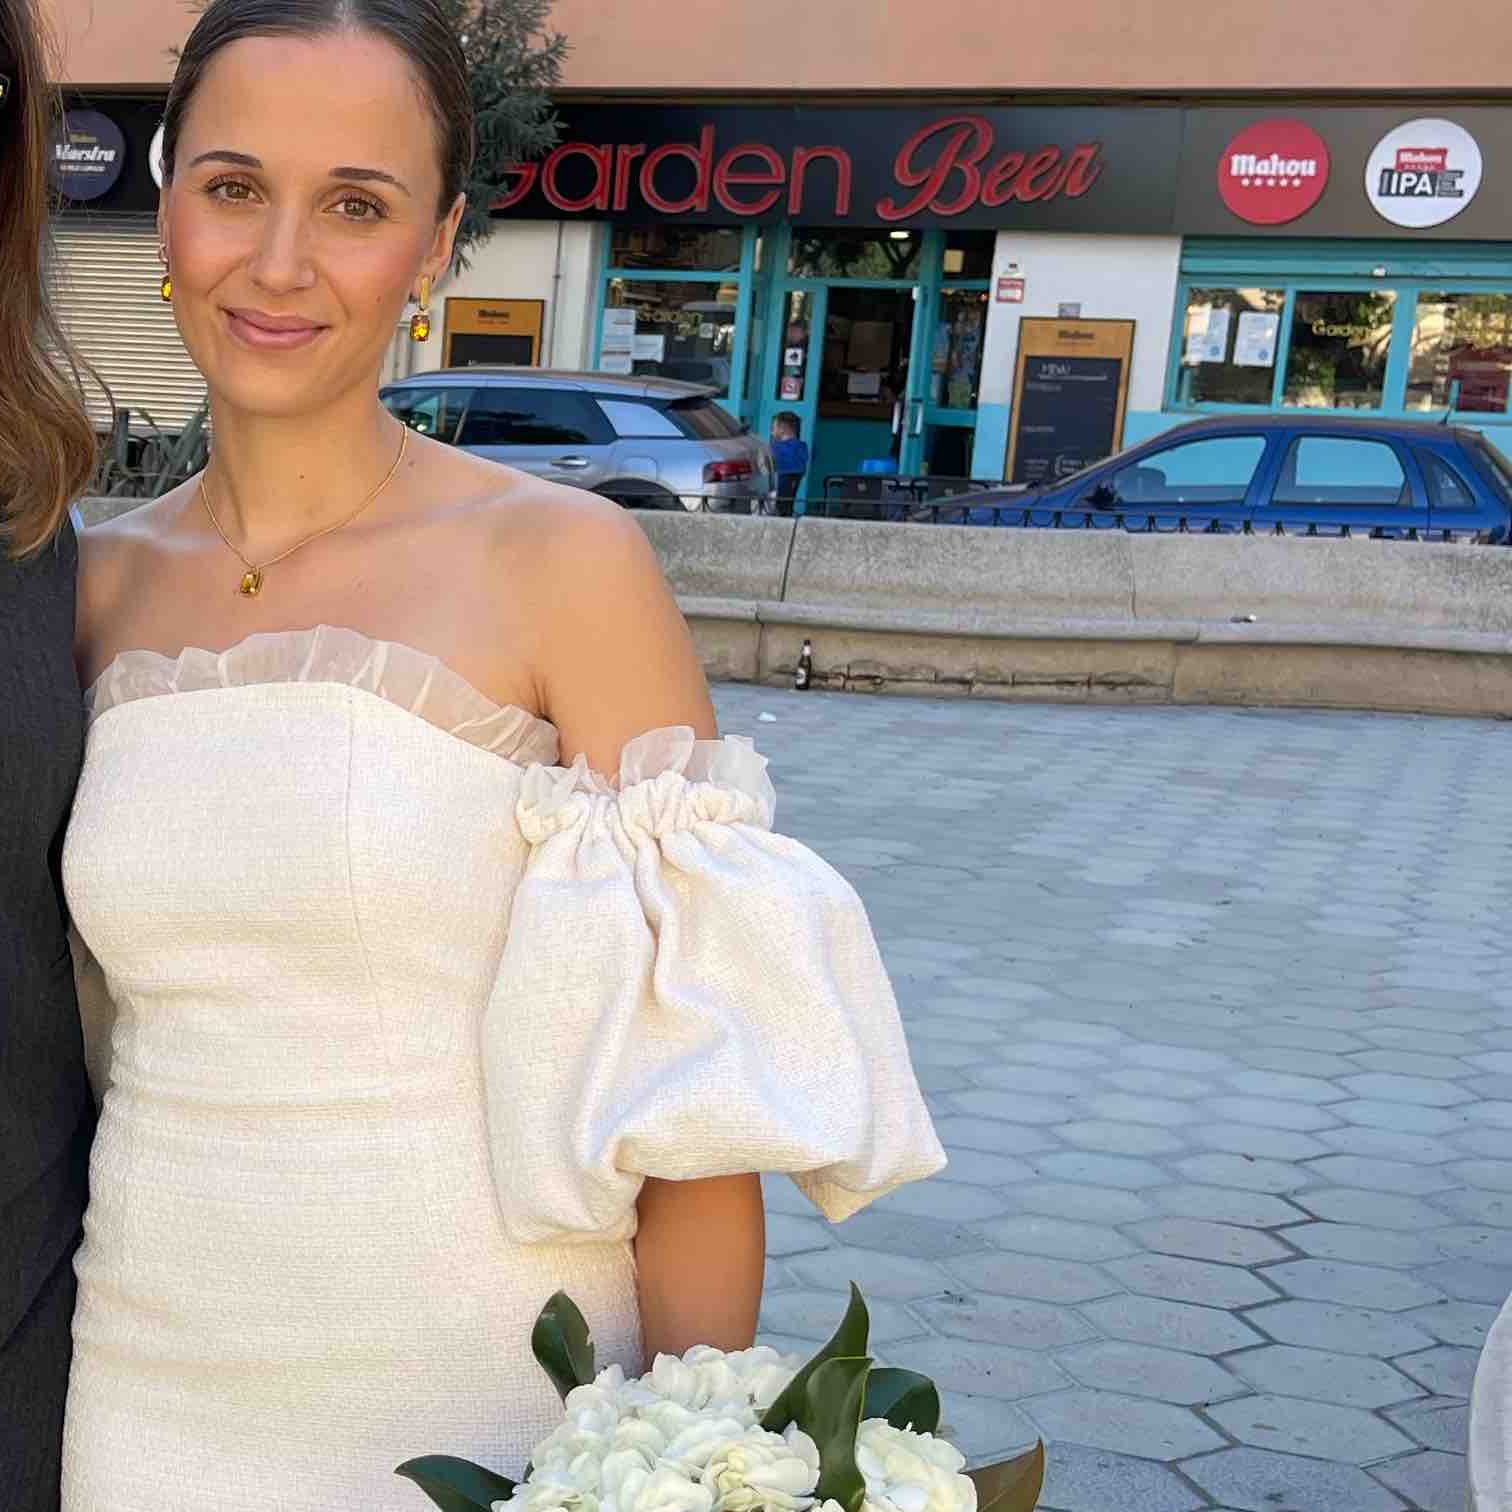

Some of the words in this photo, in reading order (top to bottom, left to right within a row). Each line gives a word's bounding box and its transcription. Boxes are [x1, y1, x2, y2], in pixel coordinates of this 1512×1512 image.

[876, 113, 1104, 221] Beer
[1230, 154, 1316, 177] Mahou
[1391, 172, 1433, 196] IPA
